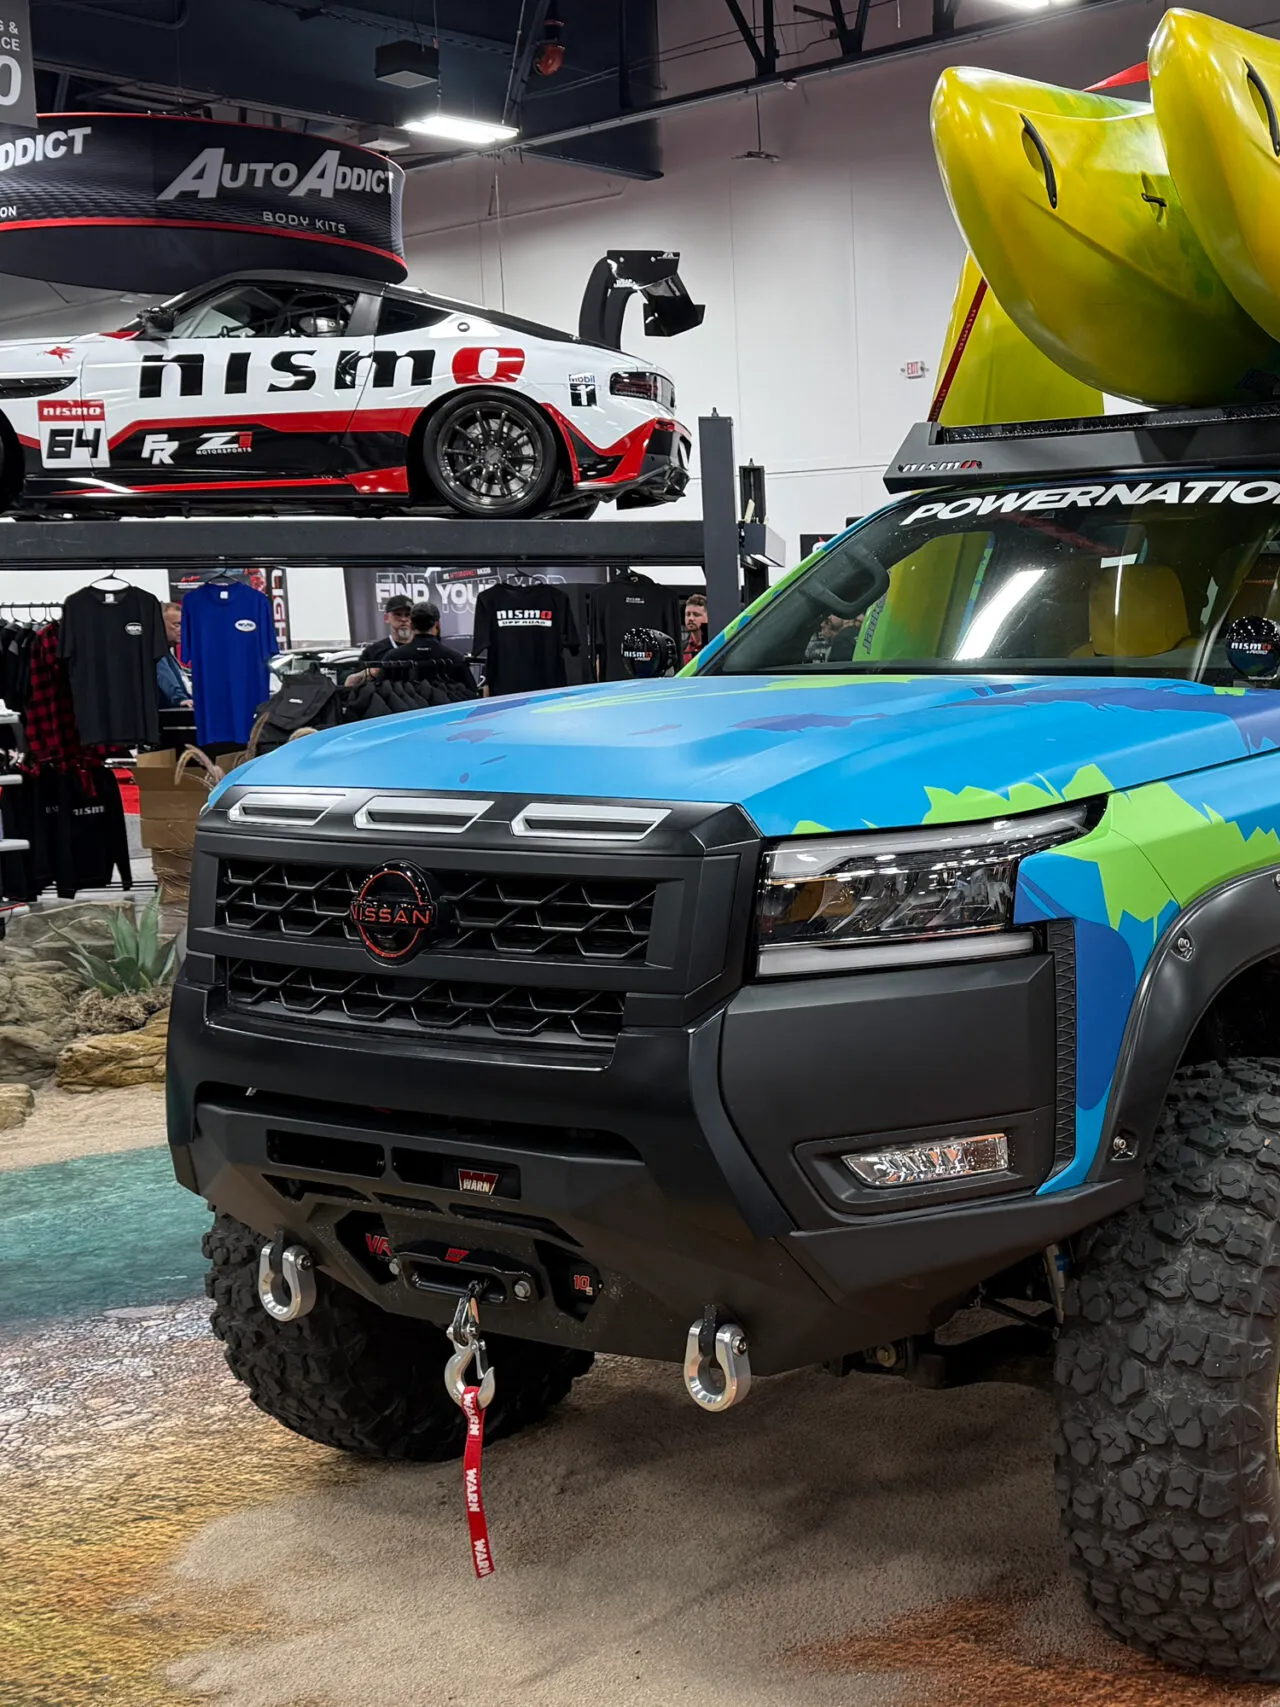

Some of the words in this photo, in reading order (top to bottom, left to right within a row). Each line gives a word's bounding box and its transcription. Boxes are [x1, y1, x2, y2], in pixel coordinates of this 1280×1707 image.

[263, 211, 309, 226] BODY
[316, 219, 347, 234] KITS
[138, 347, 525, 399] nismo
[42, 406, 101, 417] nismo
[46, 427, 102, 460] 64
[195, 447, 253, 456] MOTORSPORTS
[900, 460, 982, 473] nismo
[375, 583, 430, 604] FIND
[496, 609, 553, 620] nismo
[1231, 642, 1273, 651] nismo
[350, 905, 431, 925] NISSAN
[463, 1179, 490, 1193] WARN
[463, 1391, 480, 1436] WARN
[465, 1467, 480, 1513] WARN
[474, 1538, 493, 1577] WARN
